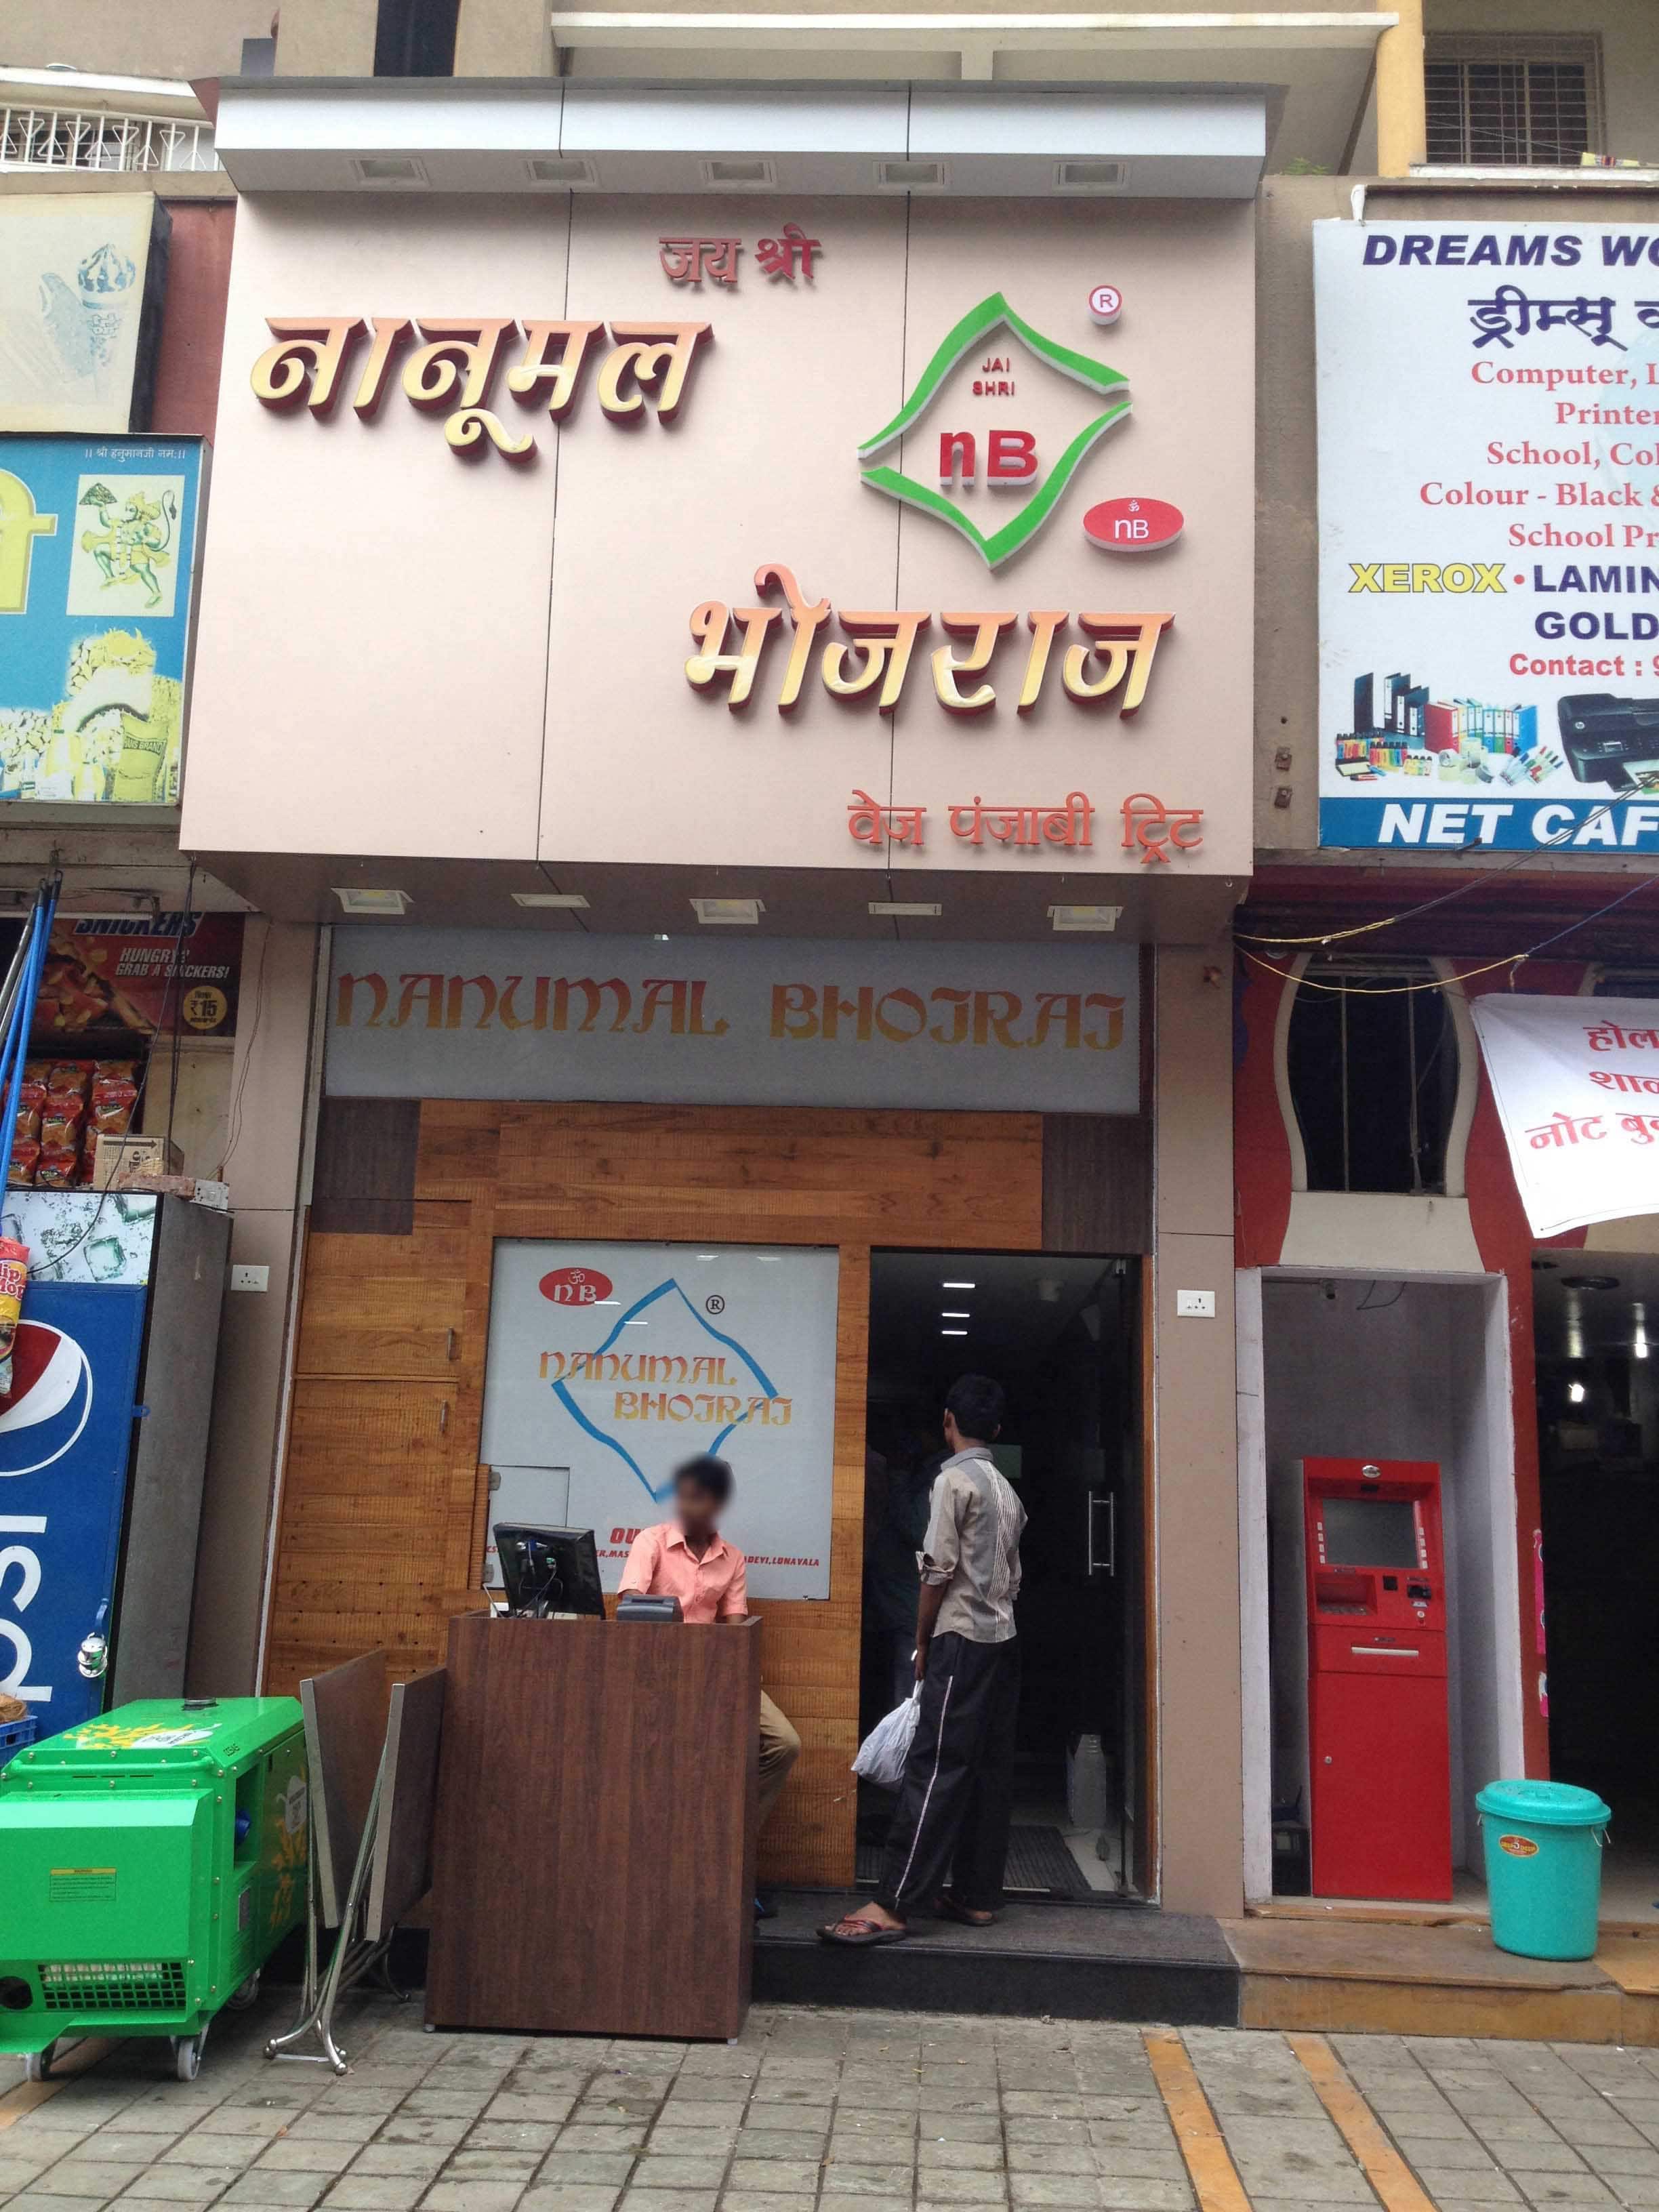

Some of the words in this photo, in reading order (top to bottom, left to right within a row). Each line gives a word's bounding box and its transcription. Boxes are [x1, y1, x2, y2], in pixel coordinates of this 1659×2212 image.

[659, 237, 741, 283] जय
[754, 222, 821, 280] श्री
[1363, 234, 1582, 266] DREAMS
[982, 357, 1010, 373] JAI
[1471, 361, 1637, 392] Computer,
[250, 316, 714, 462] नानूमल
[972, 381, 1015, 396] SHRI
[97, 447, 107, 457] श्री
[110, 448, 154, 462] हनुमानजी
[1487, 441, 1600, 470] School,
[1420, 481, 1529, 506] Colour
[1556, 482, 1643, 507] Black
[1509, 523, 1615, 547] School
[1347, 562, 1508, 594] XEROX
[1534, 565, 1659, 593] LAMIN
[684, 562, 1177, 717] भोजराज
[1534, 611, 1659, 640] GOLD
[1509, 653, 1625, 676] Contact
[847, 789, 927, 845] वेज
[947, 792, 1095, 846] पंजाबी
[1378, 804, 1513, 846] NET
[115, 963, 149, 976] GRAB
[151, 964, 161, 976] A
[336, 972, 730, 1035] NANUMAL
[771, 984, 1126, 1050] BHOJRAJ
[1525, 1111, 1607, 1149] नोट
[539, 1351, 737, 1386] NANUMAL
[613, 1391, 792, 1426] BHOJRAJ
